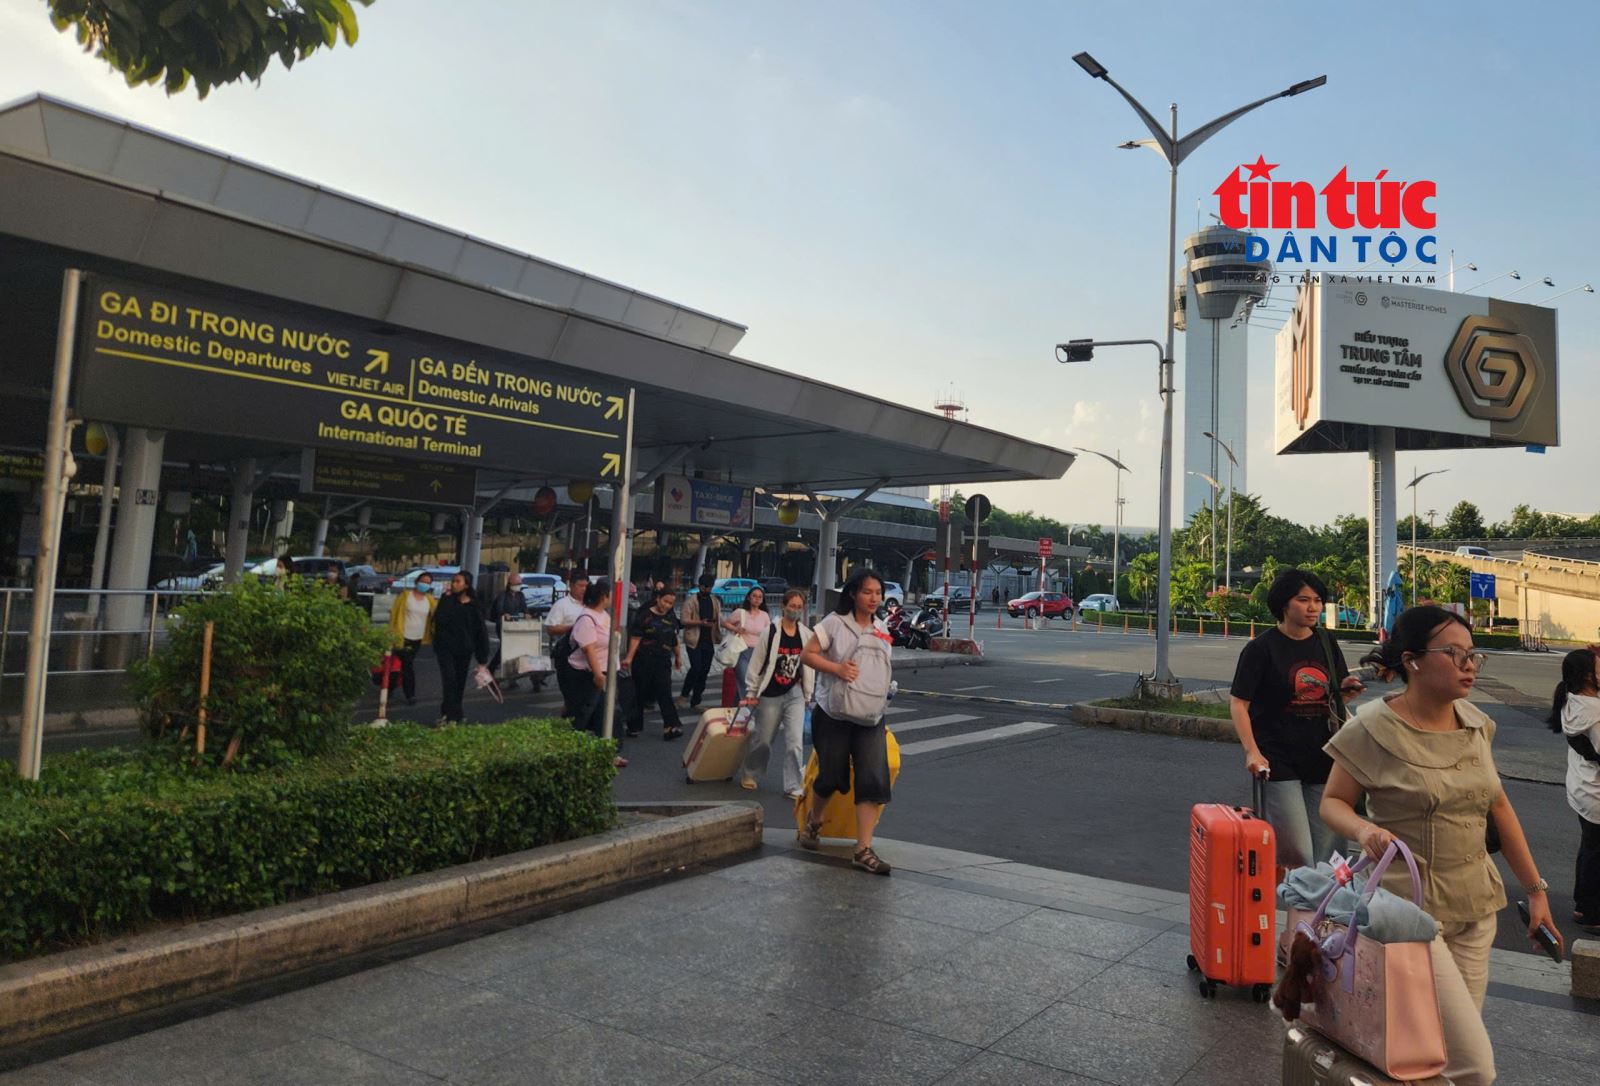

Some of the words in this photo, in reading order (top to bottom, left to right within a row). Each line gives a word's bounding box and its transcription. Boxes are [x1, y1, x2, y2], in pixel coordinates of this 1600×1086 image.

[99, 290, 143, 320] GA
[149, 301, 177, 326] ĐI
[186, 307, 275, 345] TRONG
[281, 329, 352, 360] NƯỚC
[1391, 300, 1425, 311] MASTERISE
[1425, 305, 1447, 314] HOMES
[96, 319, 202, 356] Domestic
[207, 340, 314, 376] Departures
[1340, 344, 1390, 364] TRUNG
[1393, 347, 1422, 368] TÂM
[326, 370, 382, 392] VIETJET
[382, 382, 405, 396] AIR
[417, 379, 488, 406] Domestic
[488, 393, 541, 415] Arrivals
[419, 357, 448, 379] GA
[451, 360, 490, 387] ĐẾN
[494, 371, 553, 398] TRONG
[556, 384, 603, 407] NƯỚC
[340, 400, 374, 423] GA
[317, 421, 418, 449] International
[421, 436, 482, 458] Terminal
